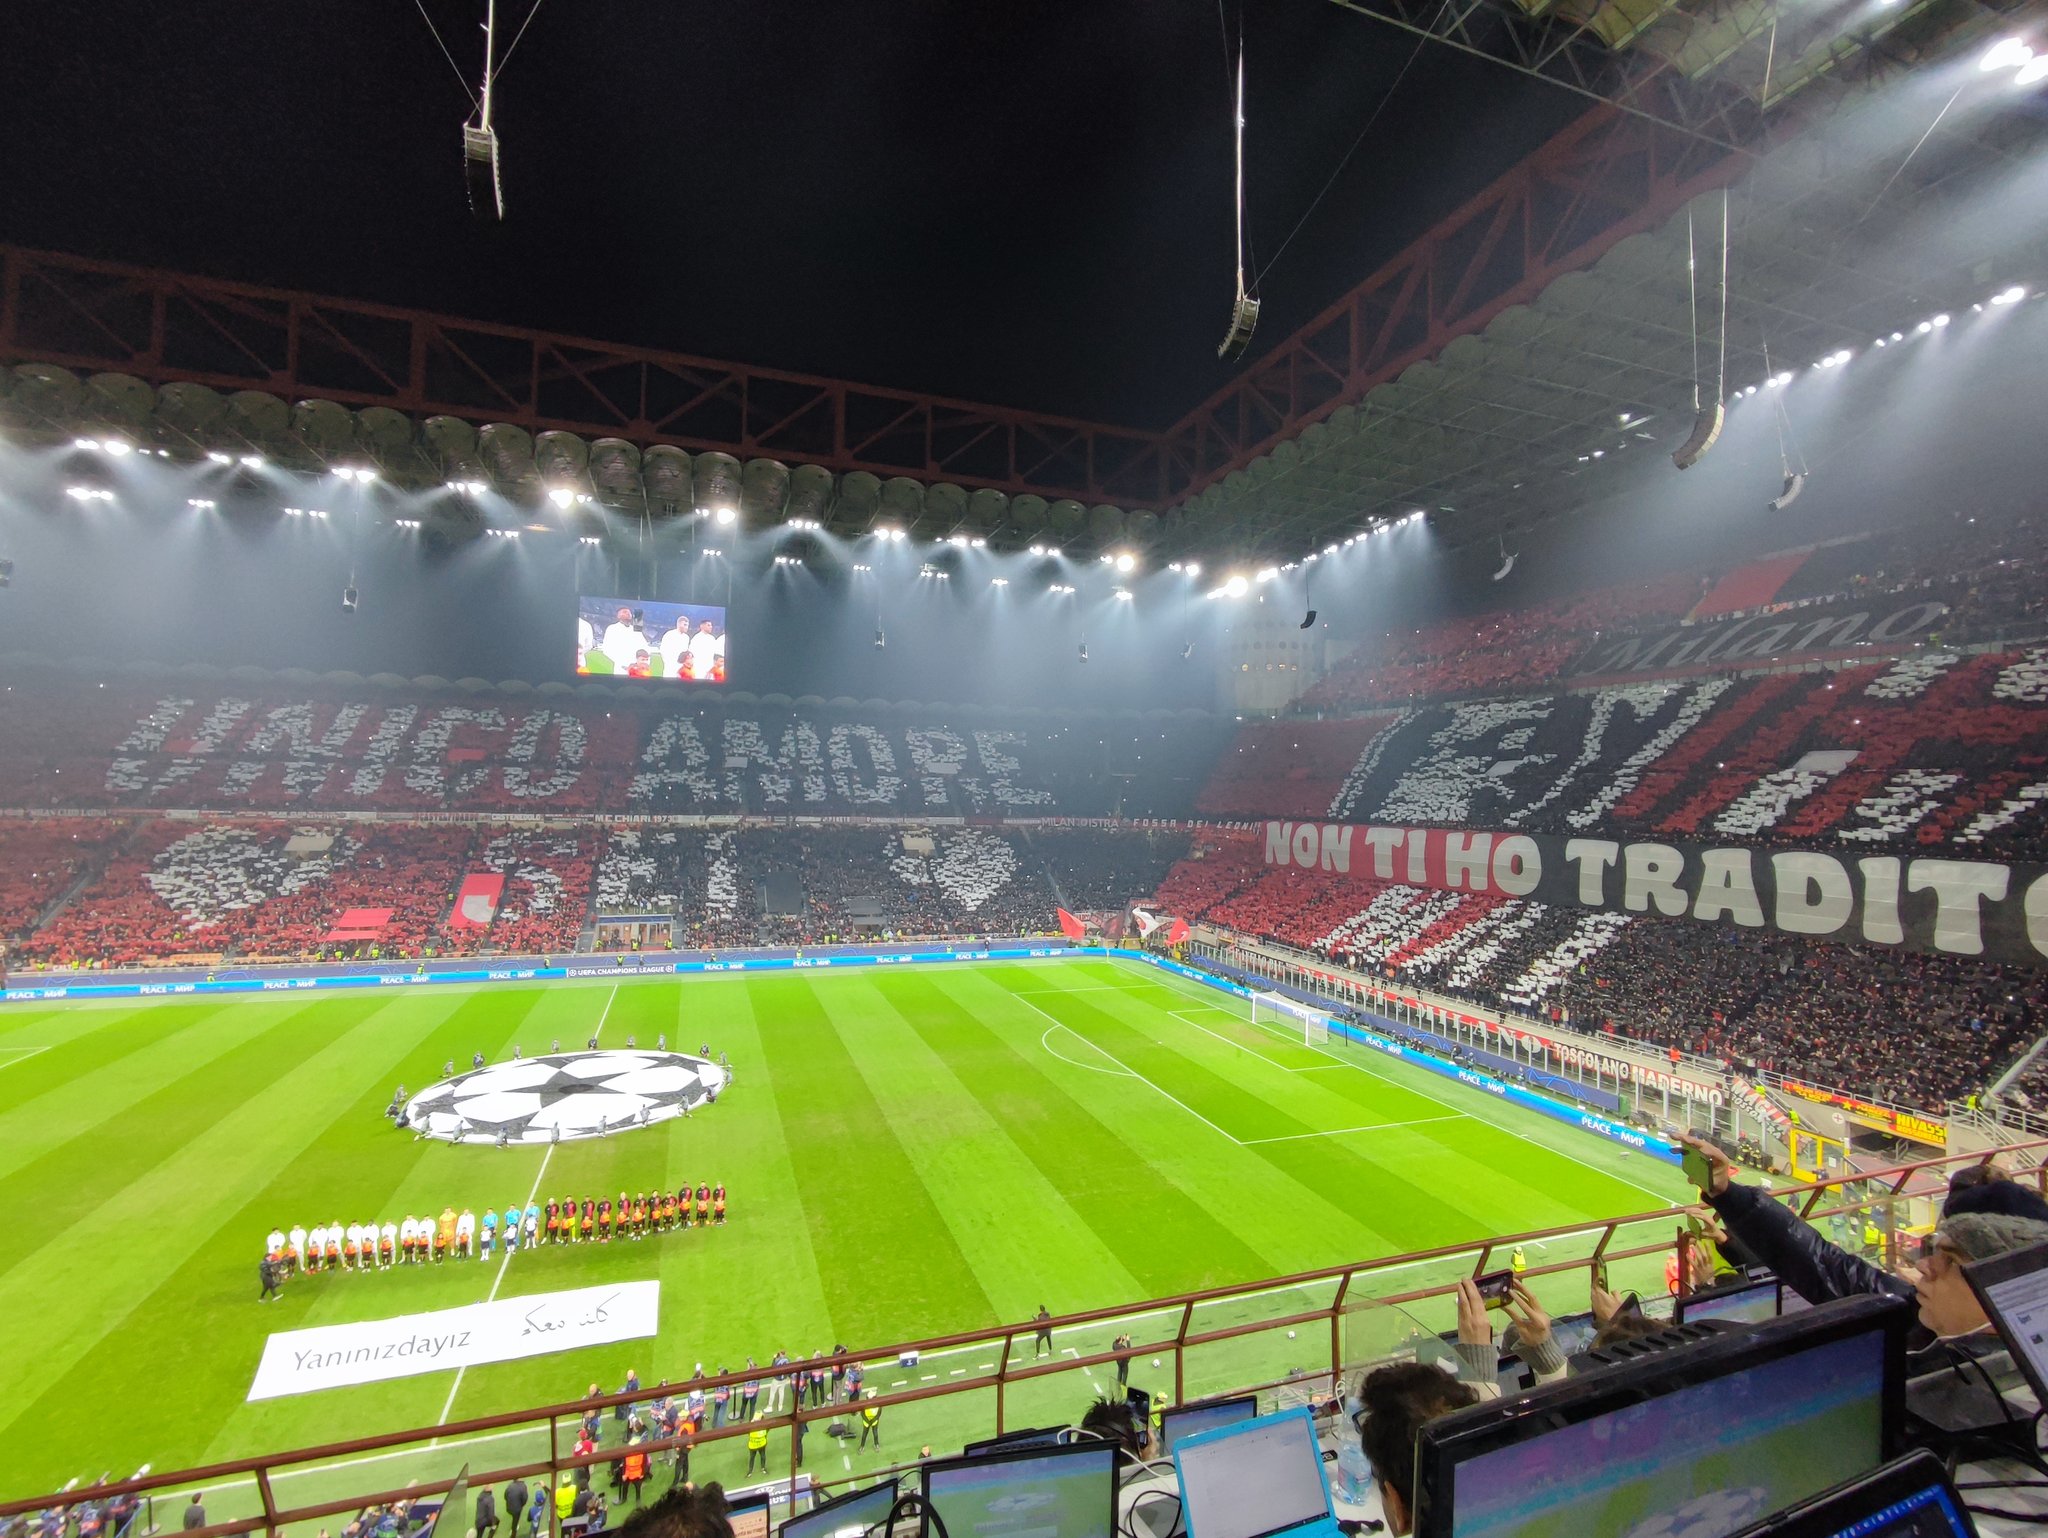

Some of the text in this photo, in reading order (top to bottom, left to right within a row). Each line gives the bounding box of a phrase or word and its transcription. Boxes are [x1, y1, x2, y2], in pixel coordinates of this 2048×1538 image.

[1571, 601, 1946, 678] Milano
[1264, 820, 2048, 956] NON TI HO TRADIT
[578, 968, 596, 976] UEFA
[597, 967, 637, 975] CHAMPIONS
[140, 985, 167, 993] PEACE
[264, 981, 289, 989] PEACE
[7, 991, 36, 999] PEACE
[1366, 1036, 1383, 1048] PEACE
[1458, 1070, 1481, 1086] PEACE
[1554, 1043, 1724, 1106] TOSCOLANO MADERNO
[1581, 1116, 1645, 1147] PEACE МИР
[294, 1328, 471, 1371] Yanınızdayız
